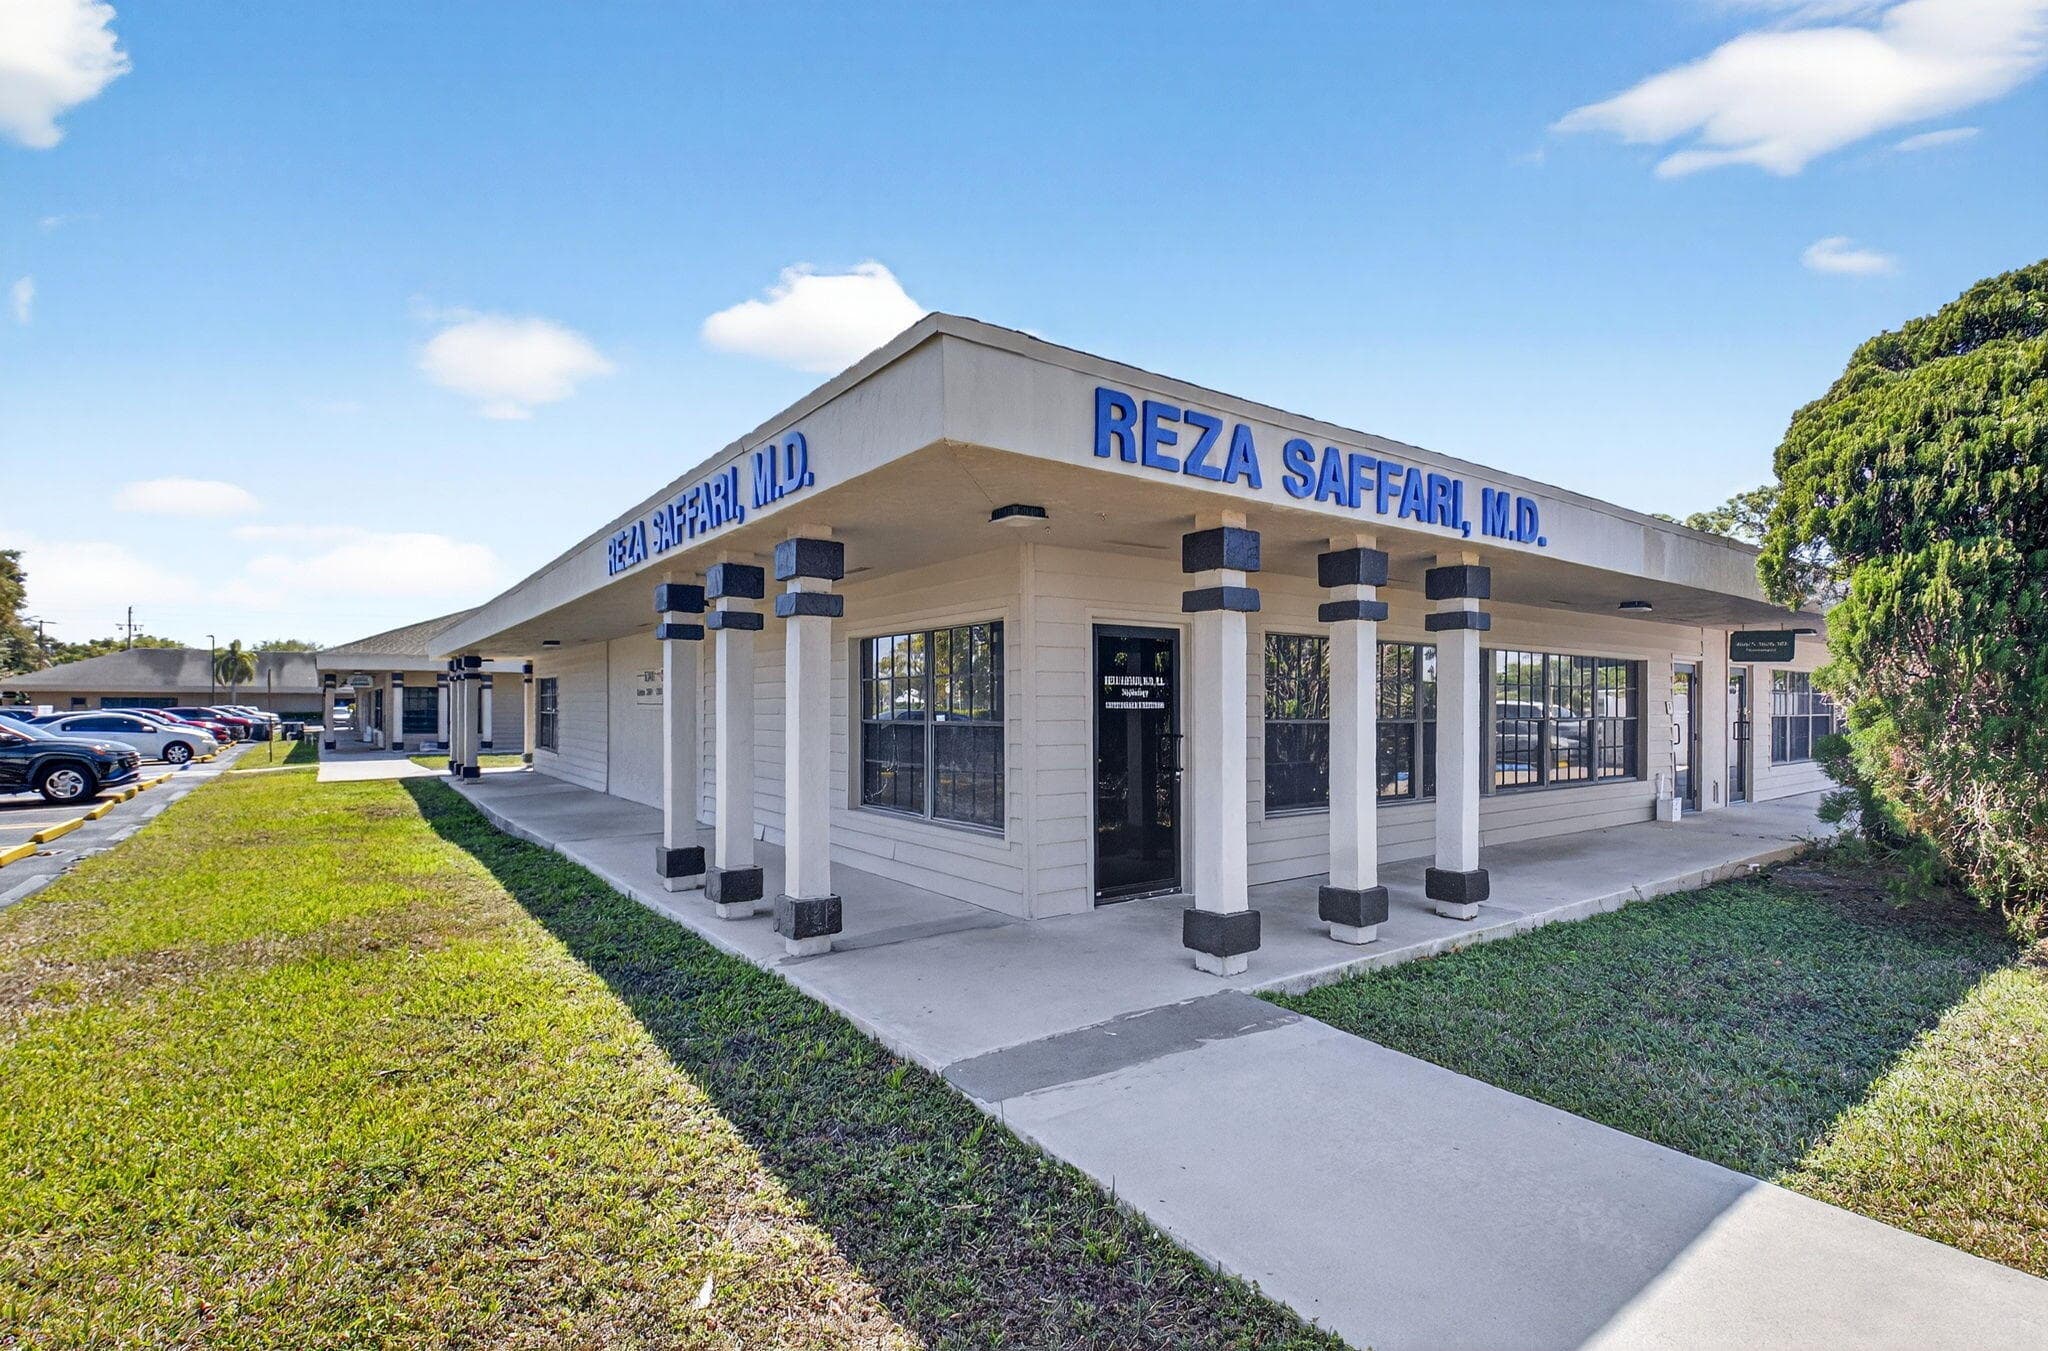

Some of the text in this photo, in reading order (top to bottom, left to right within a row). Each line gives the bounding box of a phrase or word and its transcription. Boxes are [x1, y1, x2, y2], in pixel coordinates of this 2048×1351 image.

[607, 431, 815, 576] REZA SAFFARI, M.D.
[1094, 386, 1547, 547] REZA SAFFARI, M.D.
